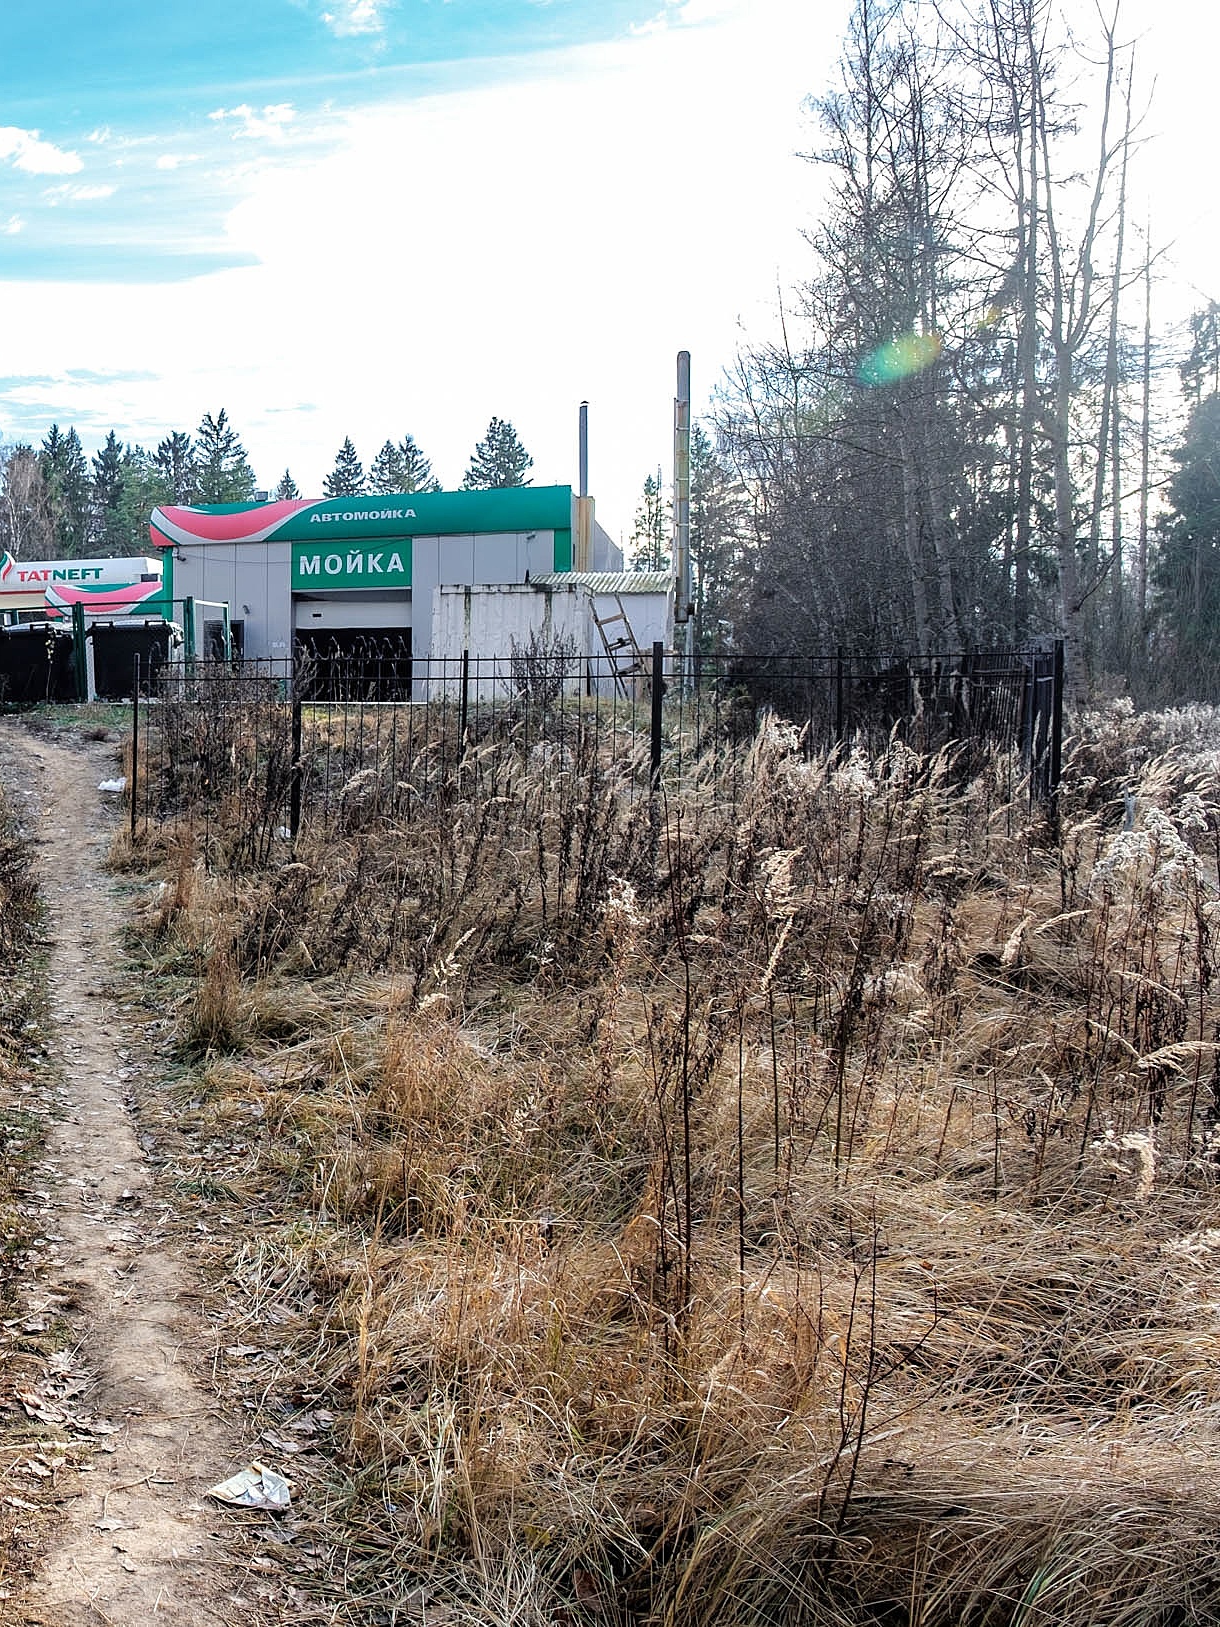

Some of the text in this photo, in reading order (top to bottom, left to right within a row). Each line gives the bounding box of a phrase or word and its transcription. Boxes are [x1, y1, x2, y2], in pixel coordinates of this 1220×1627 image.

[310, 508, 417, 523] АВТОМОЙКА
[299, 549, 405, 575] МОЙКА
[17, 567, 104, 582] TATNEFT
